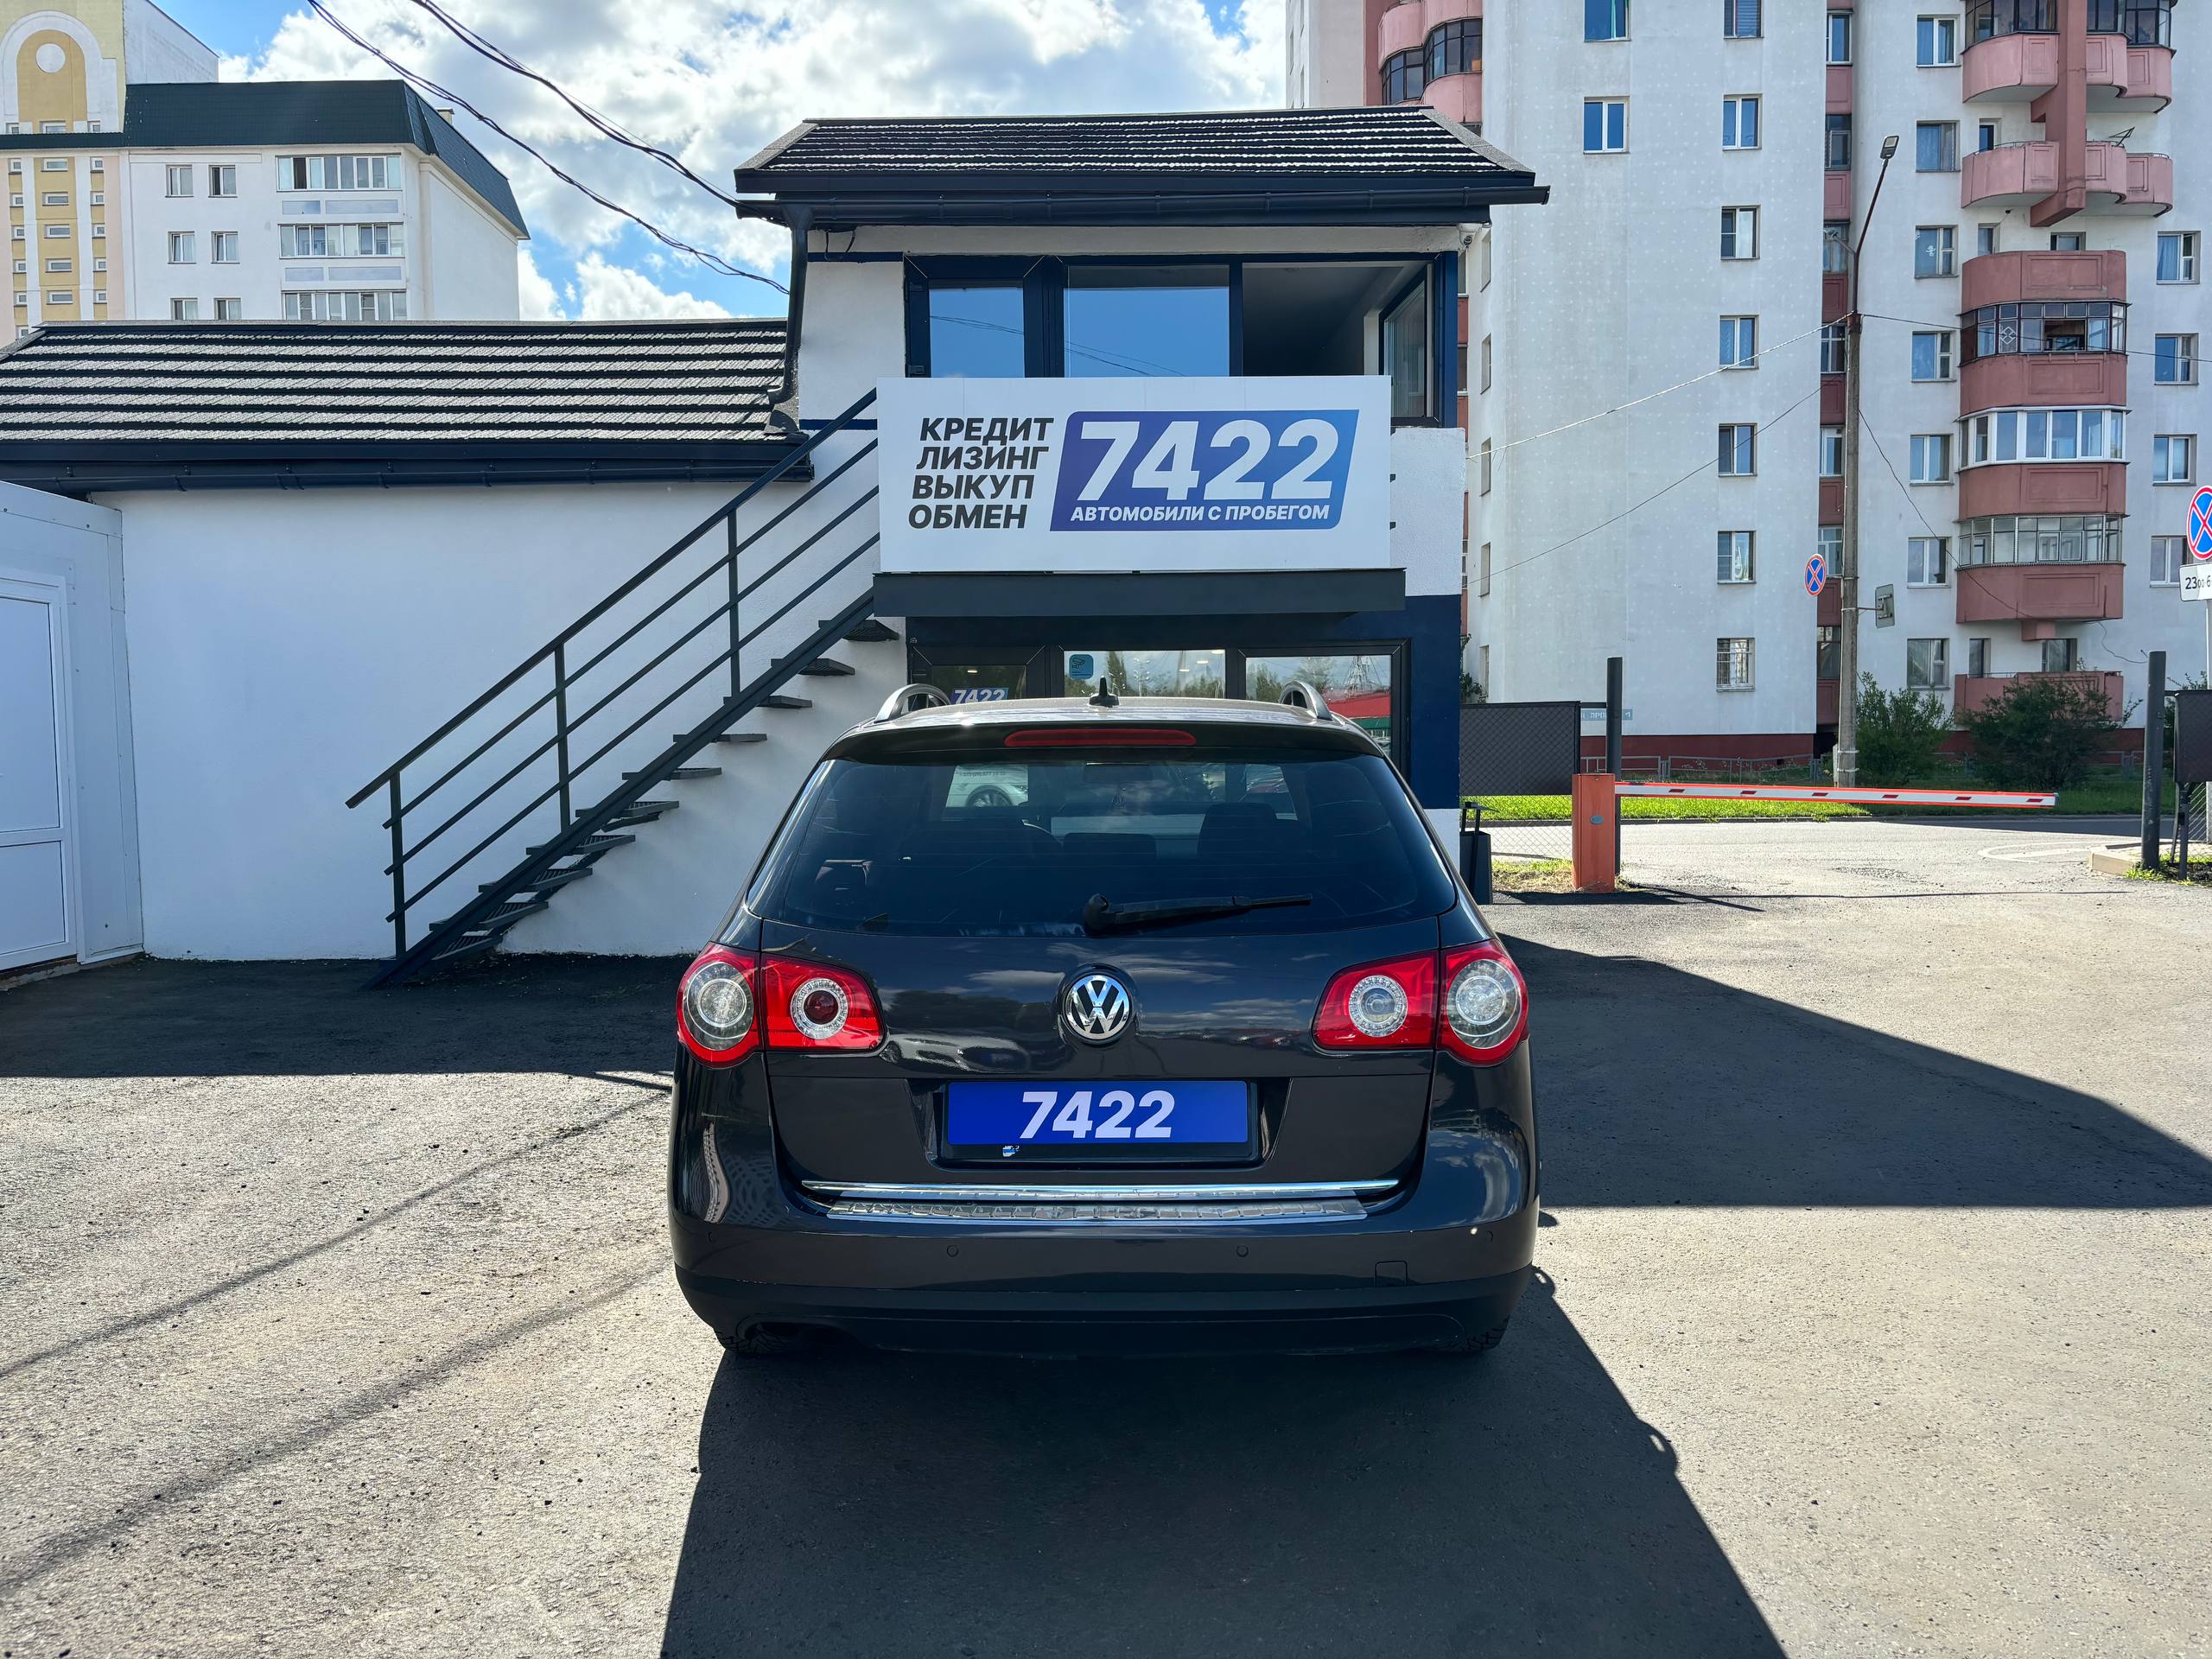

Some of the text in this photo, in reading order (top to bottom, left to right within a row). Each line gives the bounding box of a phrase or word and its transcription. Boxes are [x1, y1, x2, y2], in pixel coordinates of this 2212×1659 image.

[919, 417, 1054, 446] КРЕДИТ
[916, 446, 1049, 470] ЛИЗИНГ
[1077, 418, 1339, 501] 7422
[912, 474, 1034, 499] ВЫКУП
[908, 504, 1027, 529] ОБМЕН
[1070, 504, 1331, 522] АВТОМОБИЛИ С ПРОБЕГОМ
[954, 689, 1005, 704] 7422
[1020, 1090, 1175, 1140] 7422
